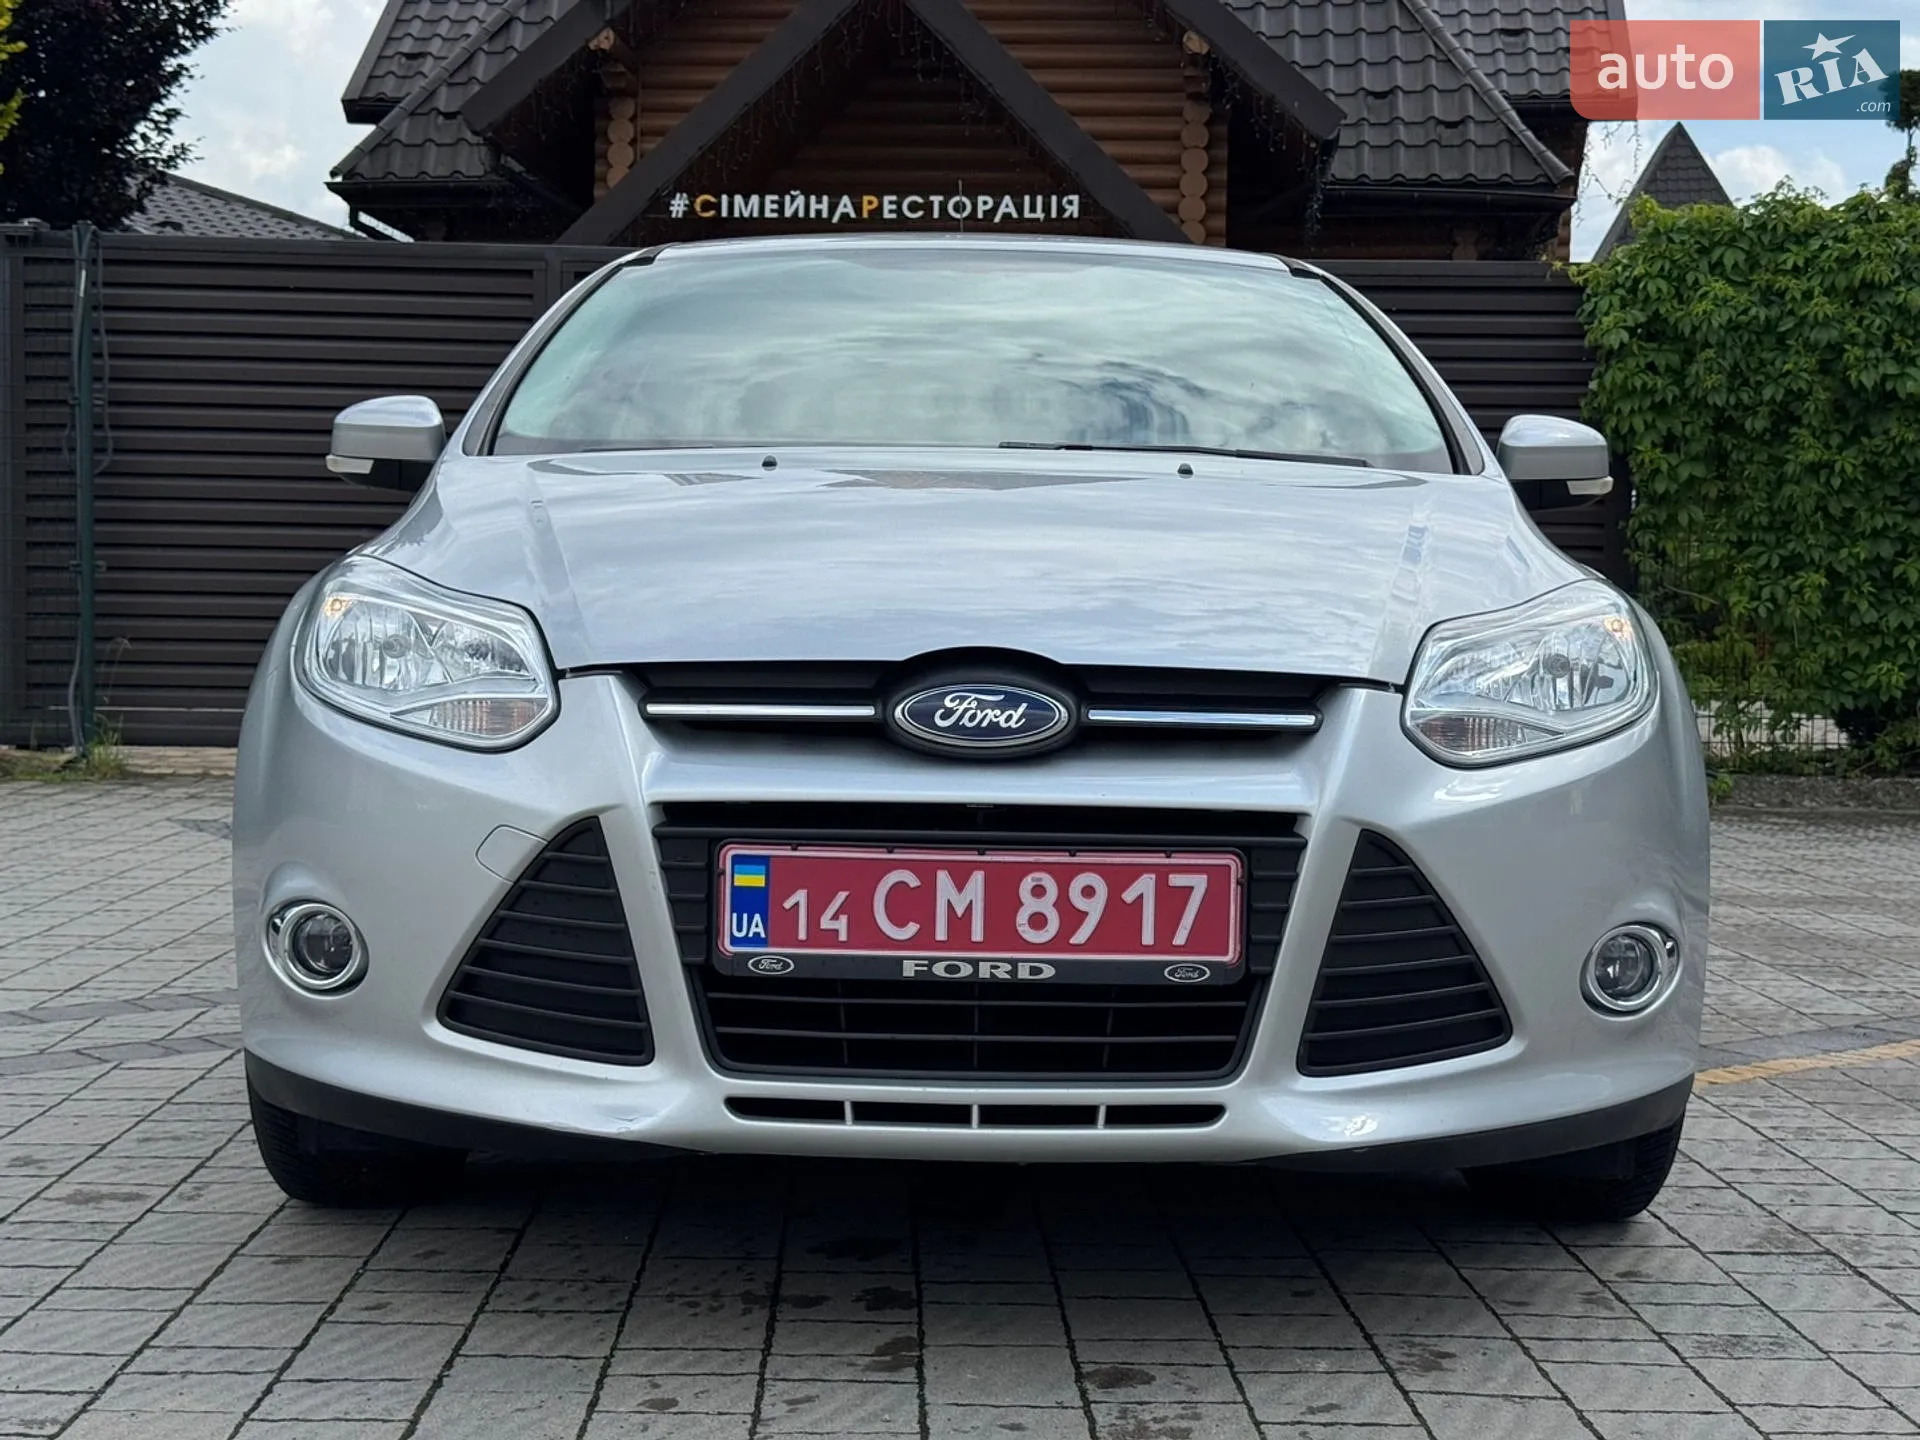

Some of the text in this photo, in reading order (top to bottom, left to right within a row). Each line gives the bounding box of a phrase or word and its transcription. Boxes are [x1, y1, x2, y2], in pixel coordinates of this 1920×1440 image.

[934, 692, 1028, 728] Ford
[782, 869, 1209, 946] 14 CM 8917
[731, 912, 766, 939] UA
[902, 959, 1057, 980] FORD
